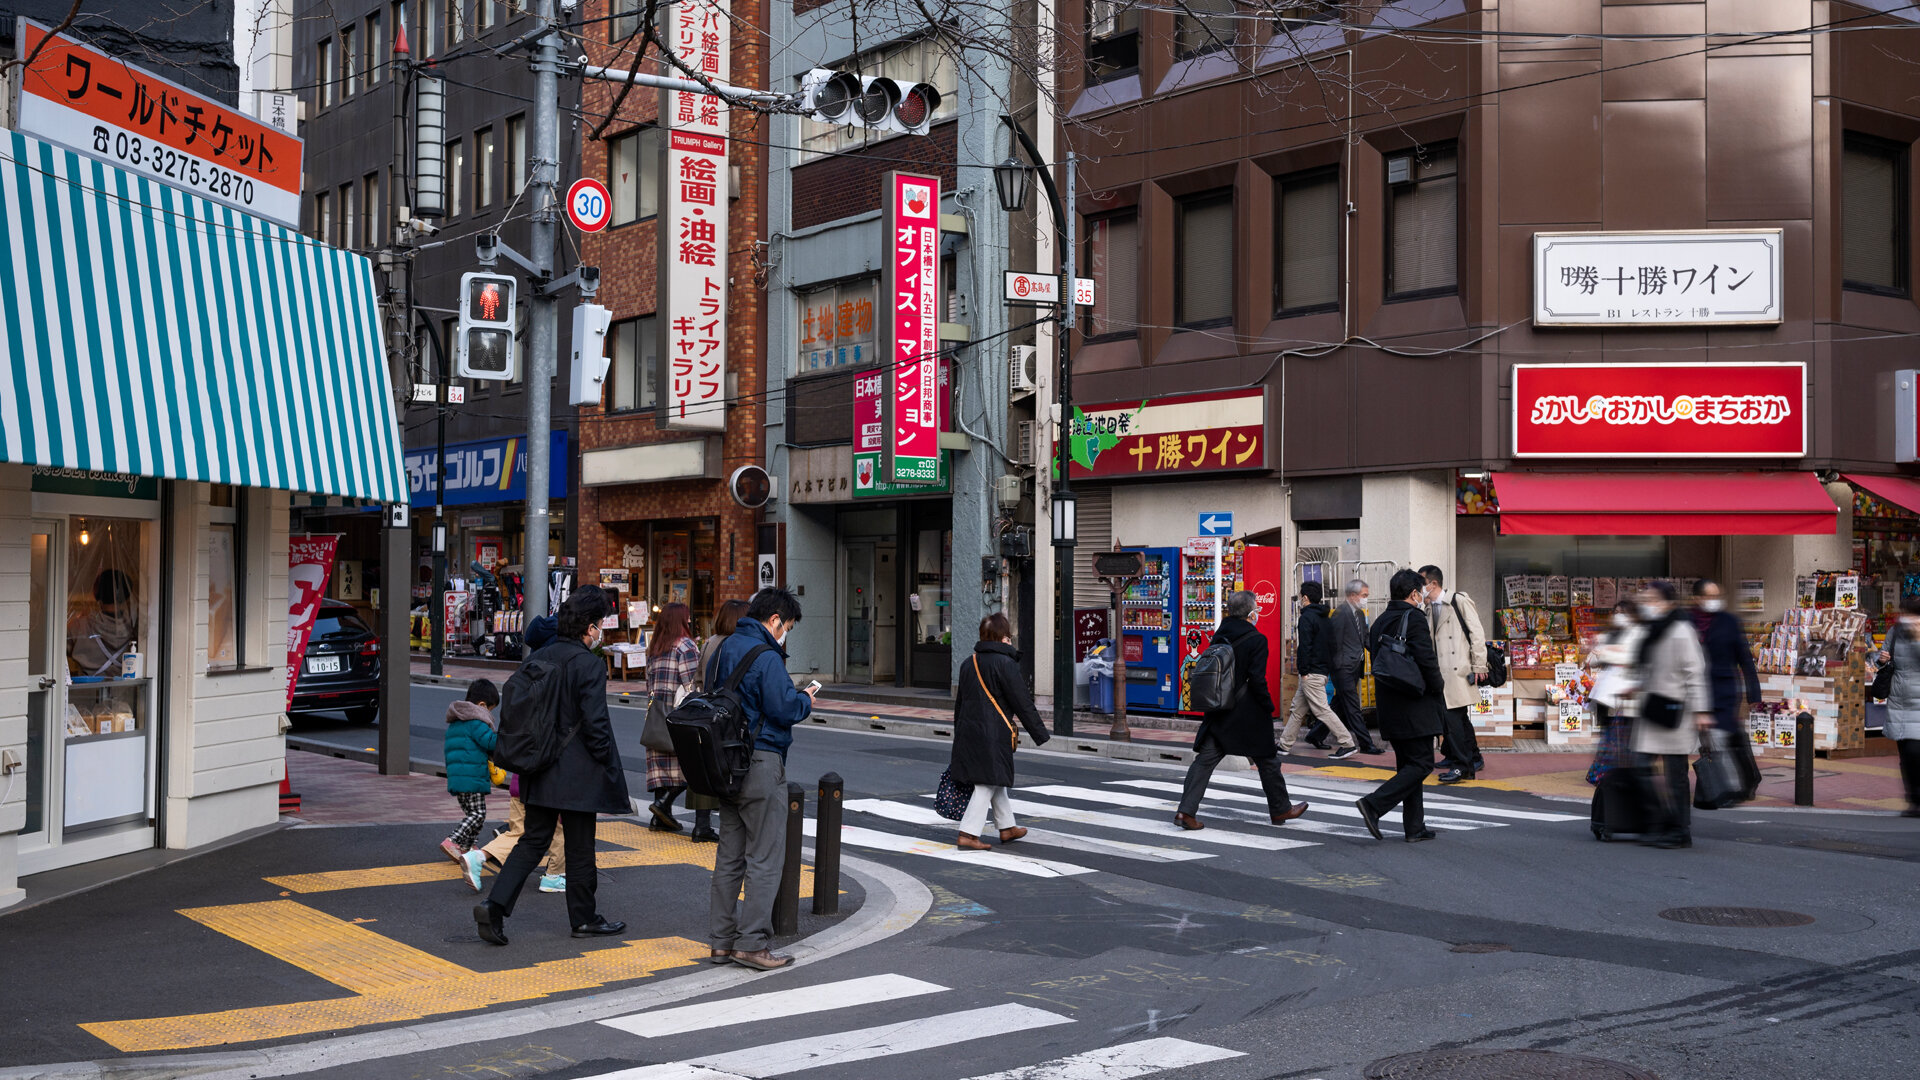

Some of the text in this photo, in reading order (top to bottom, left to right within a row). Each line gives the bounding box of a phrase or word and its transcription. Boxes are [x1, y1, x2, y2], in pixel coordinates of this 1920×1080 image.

[65, 53, 274, 173] ワールドチケット
[673, 135, 723, 150] TRIUMPH Gallery
[115, 131, 254, 205] 03-3275-2870
[577, 193, 603, 219] 30
[680, 156, 717, 266] 絵画・油絵
[1077, 289, 1092, 303] 35
[1607, 307, 1710, 318] B1 レストラン 十勝
[802, 297, 873, 344] 土地建物
[698, 276, 721, 399] トライアンフ
[897, 225, 919, 446] オフィス・マンション
[672, 316, 696, 419] ギャラリー
[450, 393, 463, 402] 34
[1068, 412, 1131, 437] 海道池田発
[1129, 430, 1257, 472] 十勝ワイン
[925, 460, 936, 469] 03
[896, 468, 935, 478] 3278-9333
[1255, 592, 1275, 604] oca-Cola
[316, 662, 339, 672] 10-15
[1566, 716, 1578, 724] 69
[1755, 730, 1766, 738] 99
[1780, 731, 1792, 739] 79
